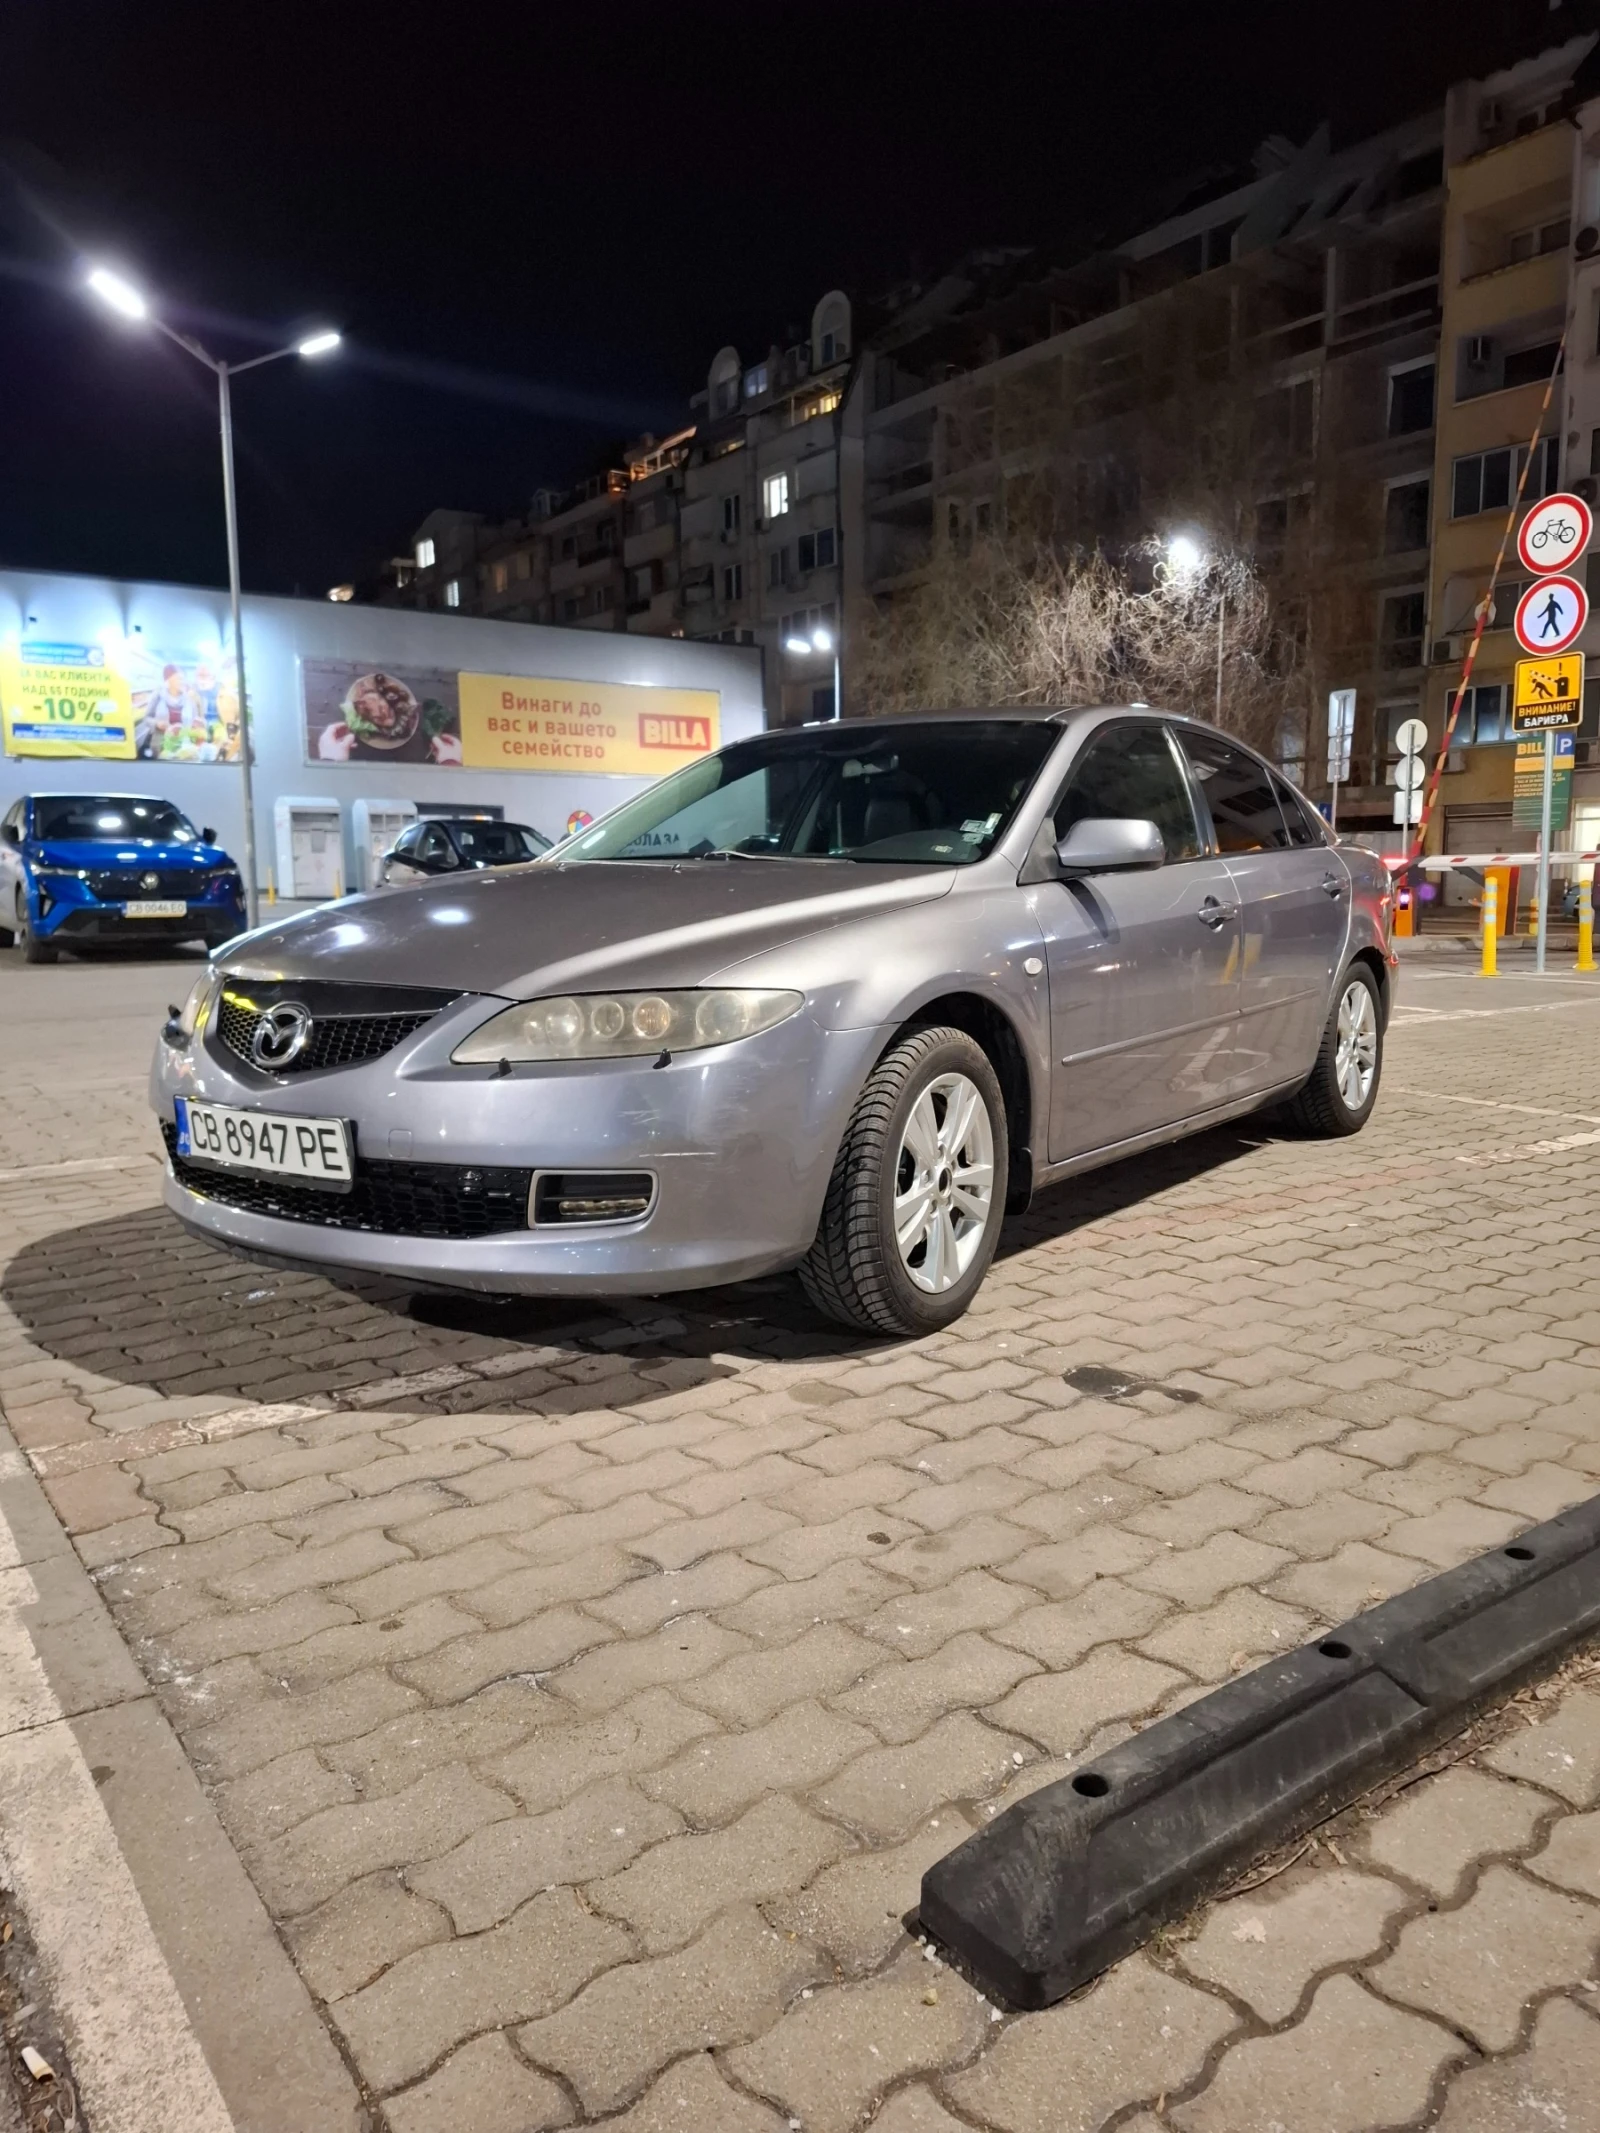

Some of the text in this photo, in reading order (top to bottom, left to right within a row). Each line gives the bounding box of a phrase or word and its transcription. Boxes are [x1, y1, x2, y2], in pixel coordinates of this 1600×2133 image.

[35, 669, 57, 680] ВАС
[60, 671, 111, 682] КЛИЕНТИ
[22, 685, 47, 696] НАД
[65, 686, 110, 698] ГОДИНИ
[33, 698, 104, 722] -10%
[501, 691, 603, 717] Винаги до
[1518, 701, 1576, 717] ВНИМАНИЕ!
[487, 717, 617, 738] вас и вашето
[1524, 714, 1569, 728] БАРИЕРА
[644, 719, 708, 747] BILLA
[502, 738, 606, 759] семейство
[1516, 741, 1546, 755] BILL
[1560, 738, 1572, 753] P
[191, 1110, 343, 1171] CB 8947 PE
